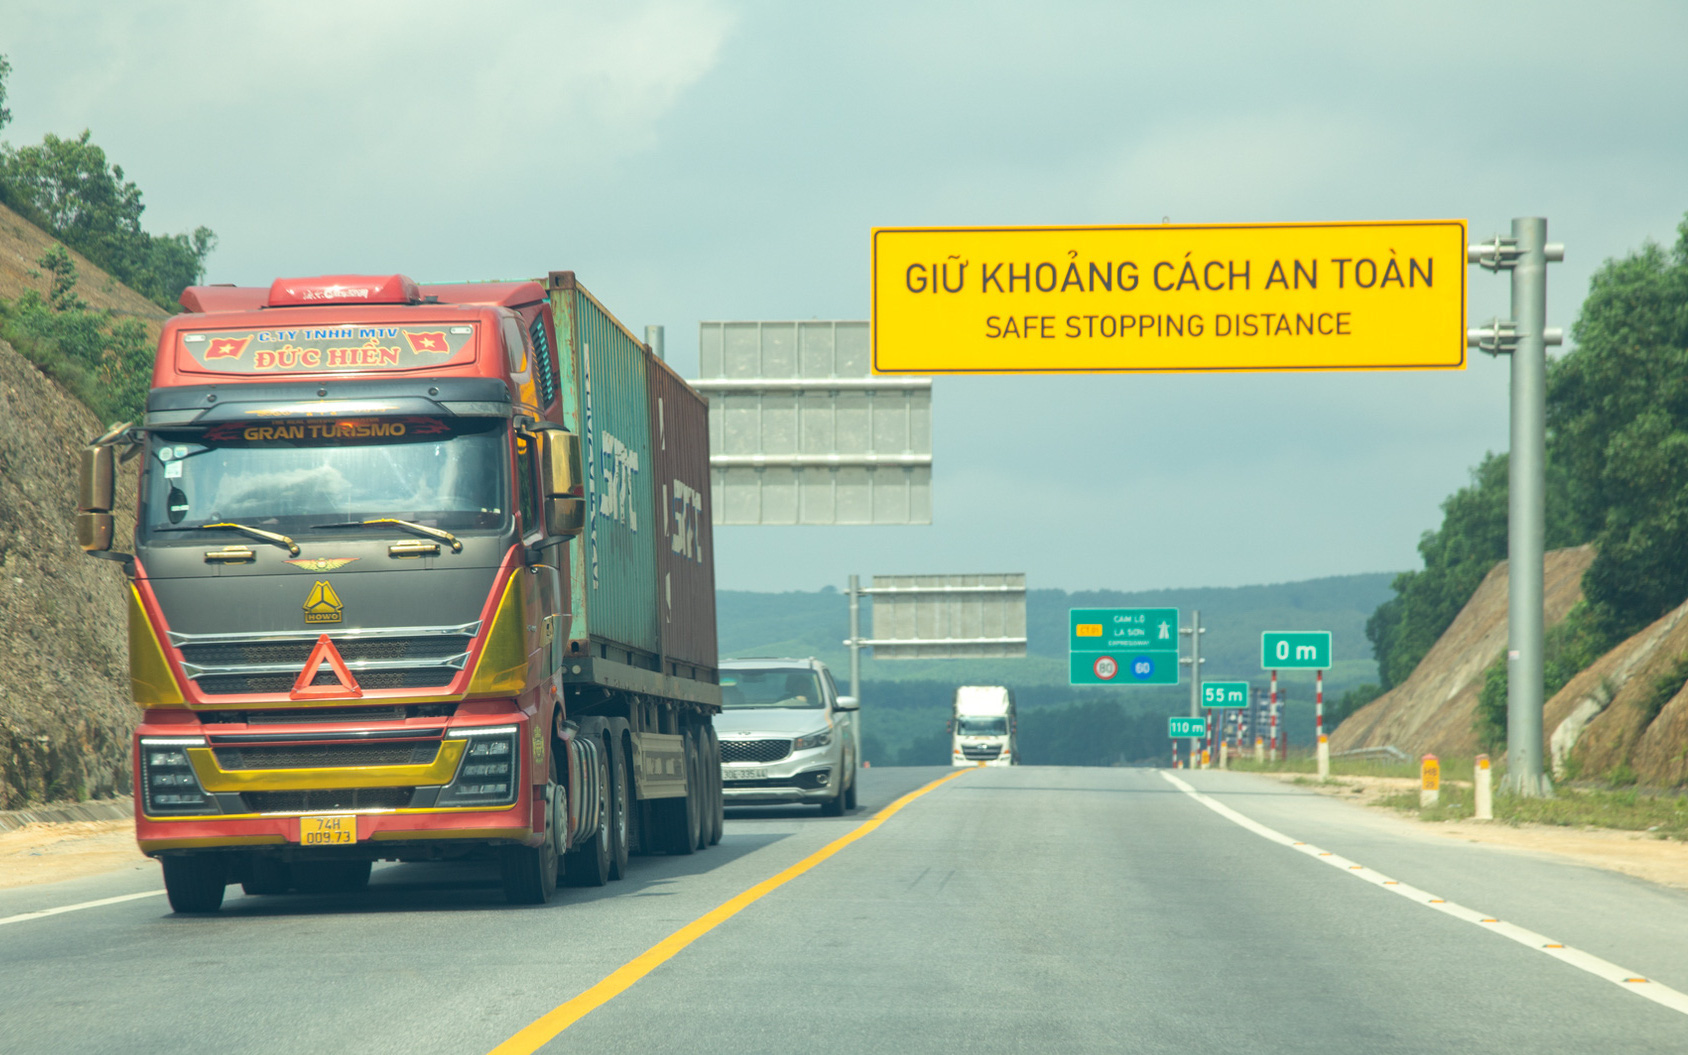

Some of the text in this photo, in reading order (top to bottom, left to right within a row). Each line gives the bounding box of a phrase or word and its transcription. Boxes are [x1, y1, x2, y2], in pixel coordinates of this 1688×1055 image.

[906, 249, 1434, 294] GIỮ KHOẢNG CÁCH AN TOÀN
[985, 312, 1352, 339] SAFE STOPPING DISTANCE
[258, 328, 399, 342] C.TY TNHH MTV
[254, 338, 401, 369] ĐỨC HIỀN
[243, 422, 406, 441] GRAN TURISMO
[308, 613, 339, 621] HOWO
[1276, 640, 1317, 660] 0 m
[1099, 662, 1113, 674] 80
[1135, 662, 1150, 674] 60
[1205, 687, 1243, 702] 55 m
[1171, 722, 1204, 733] 110 m
[316, 818, 341, 830] 74H
[306, 831, 351, 844] 009.73
